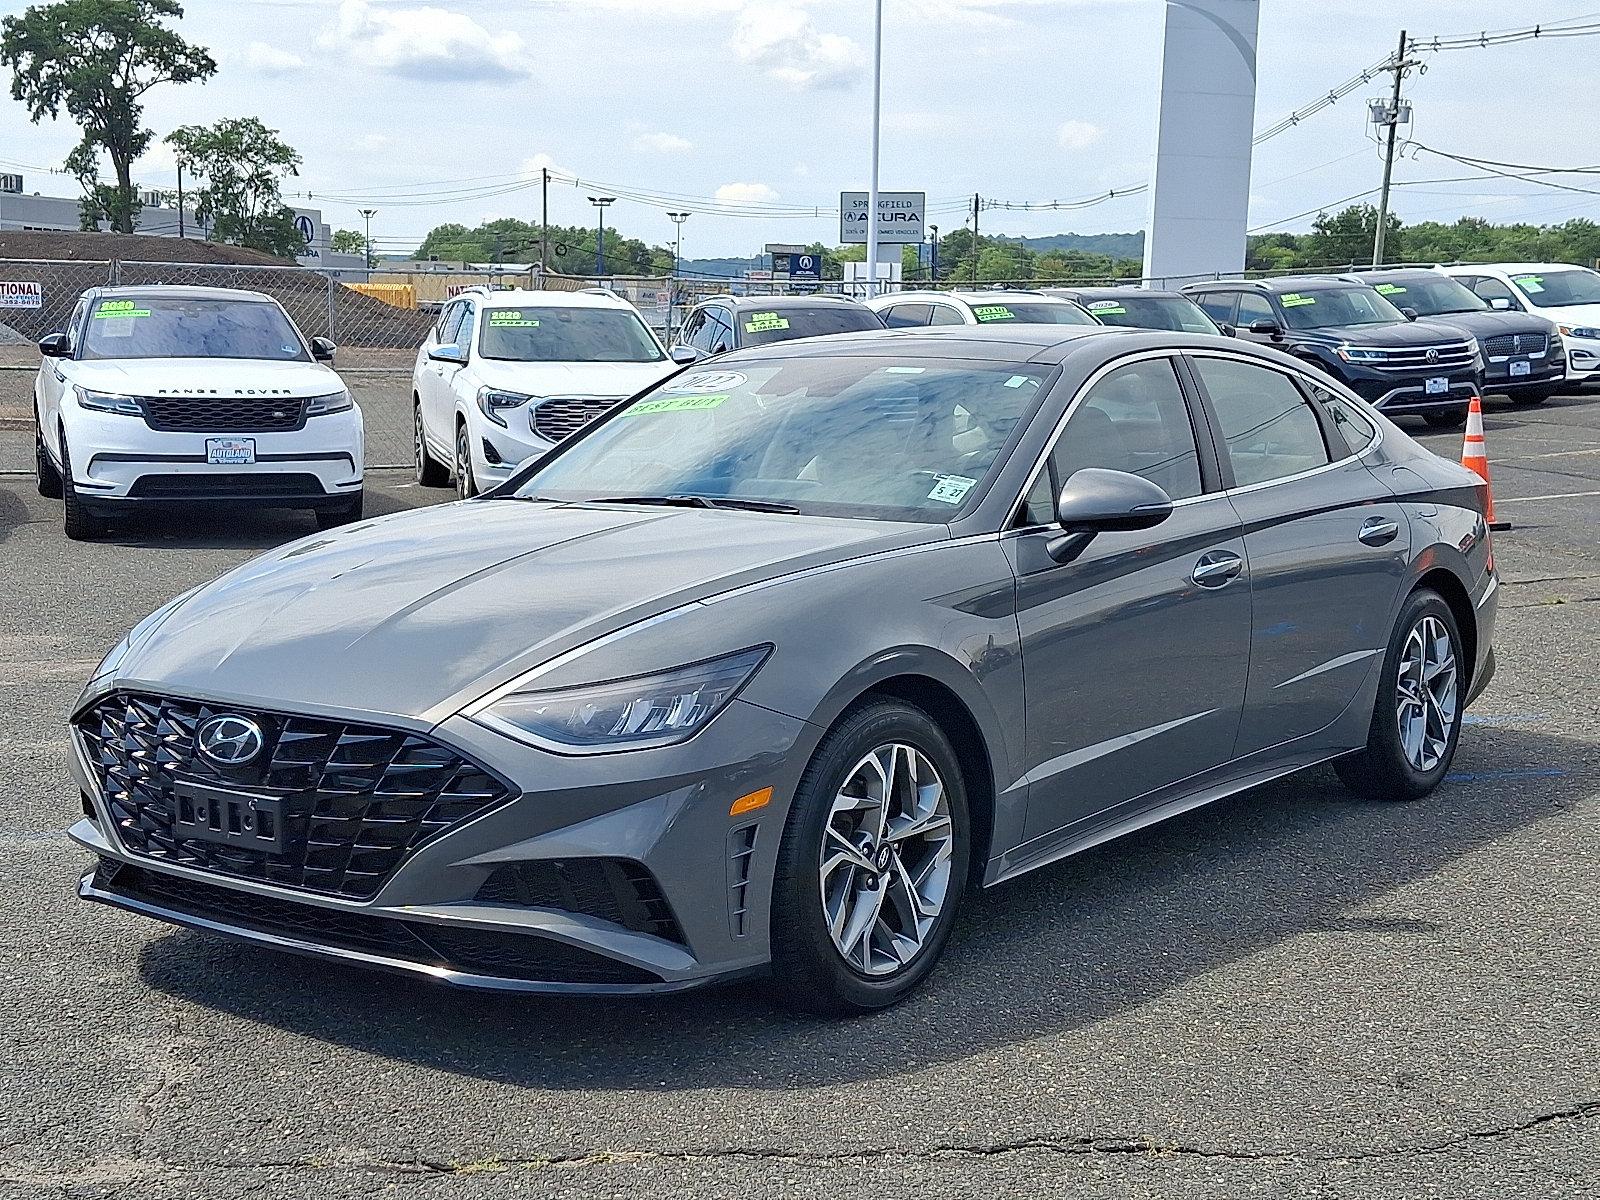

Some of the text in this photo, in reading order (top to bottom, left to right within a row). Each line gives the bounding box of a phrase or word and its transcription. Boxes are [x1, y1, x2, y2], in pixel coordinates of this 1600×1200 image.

[853, 200, 912, 209] SPRGFIELD
[857, 212, 920, 222] AURA
[490, 311, 521, 320] 2020
[625, 397, 725, 415] BEST BUY
[210, 448, 252, 459] AUTOLAND
[936, 486, 964, 498] 5 27
